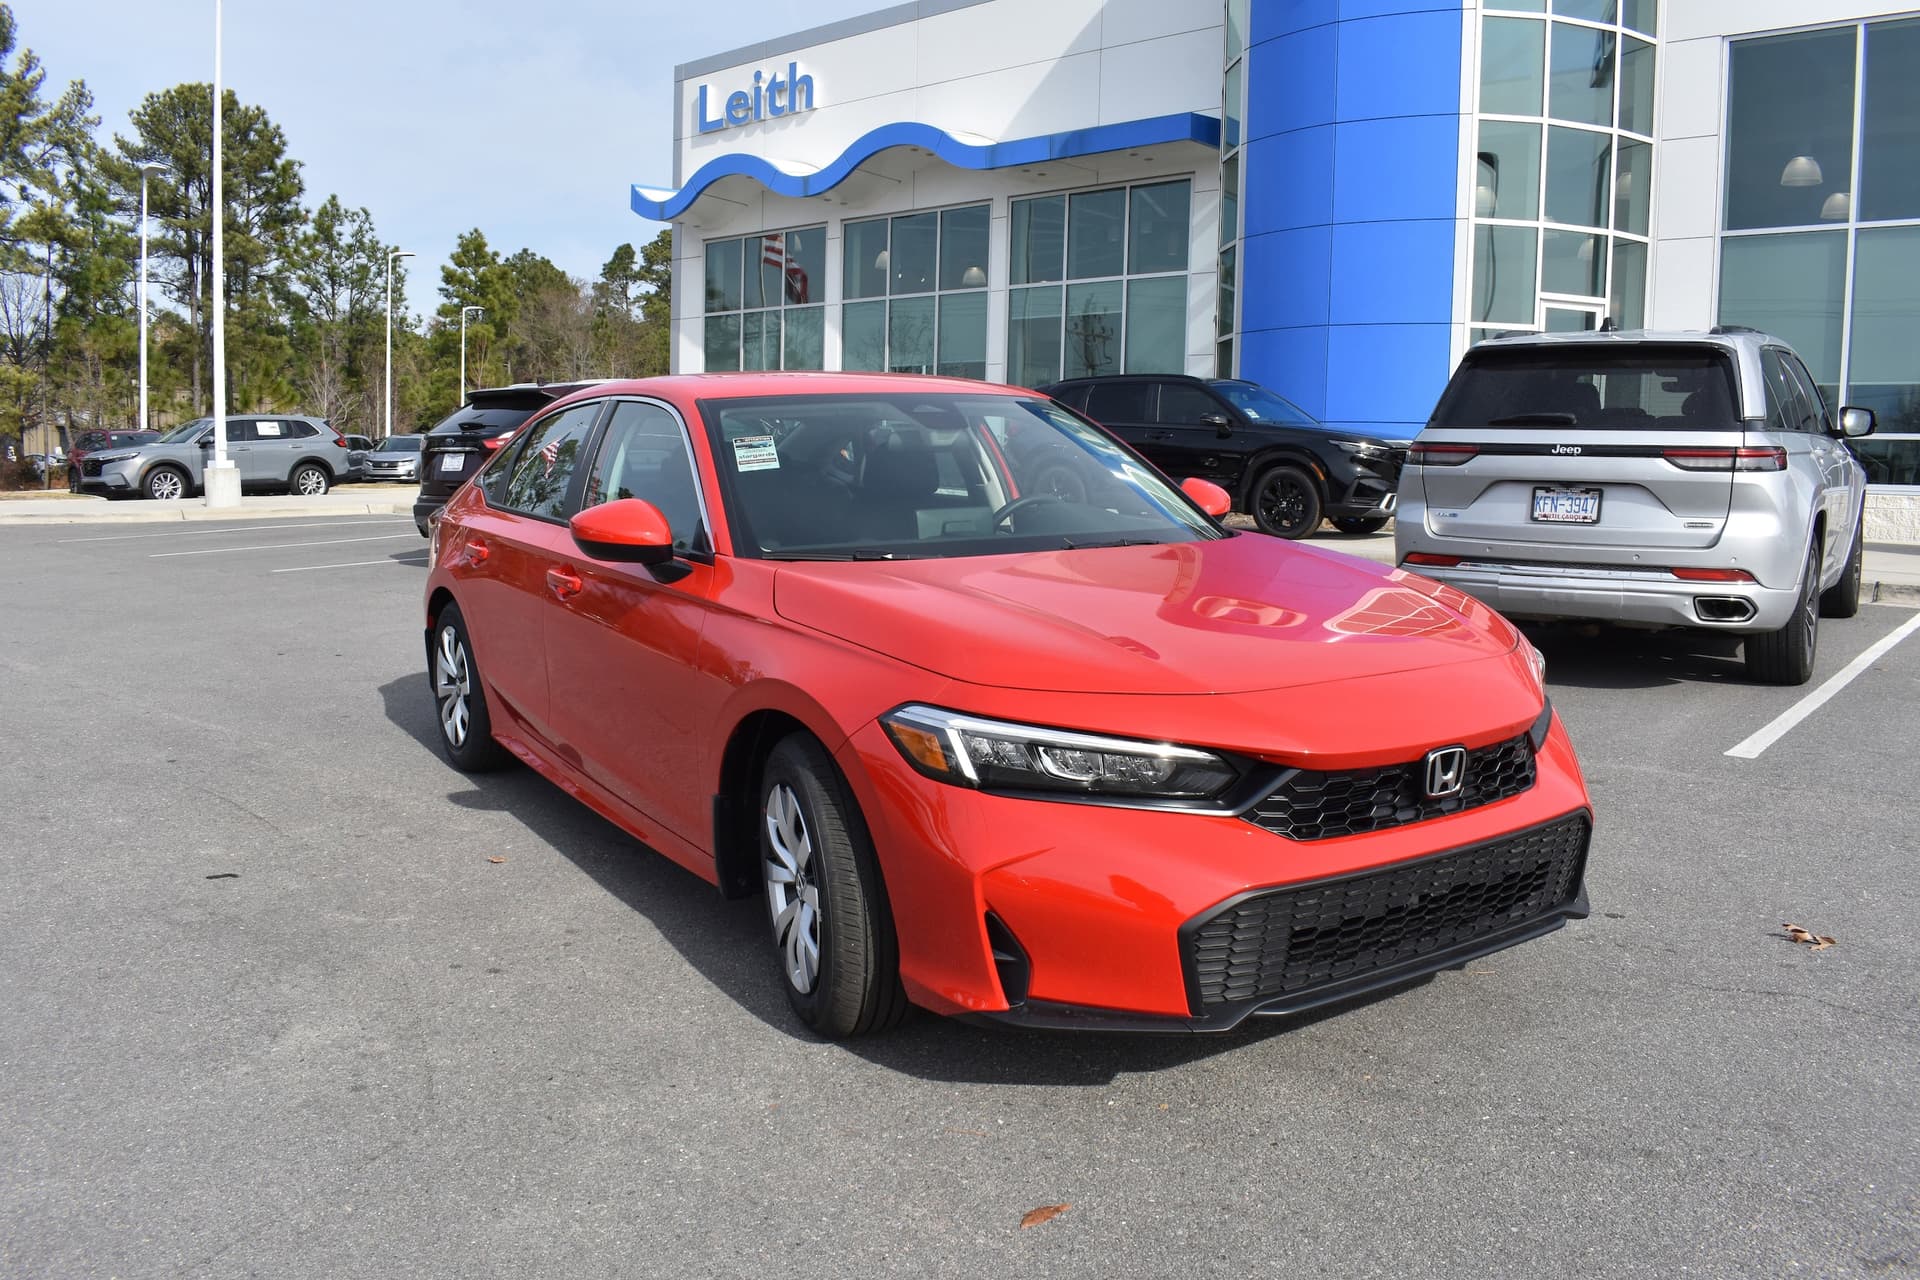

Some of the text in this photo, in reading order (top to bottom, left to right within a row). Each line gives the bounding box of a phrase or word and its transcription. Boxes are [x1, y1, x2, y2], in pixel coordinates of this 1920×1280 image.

[699, 62, 813, 133] Leith
[1551, 444, 1581, 456] Jeep
[1535, 495, 1597, 514] KFN-3947
